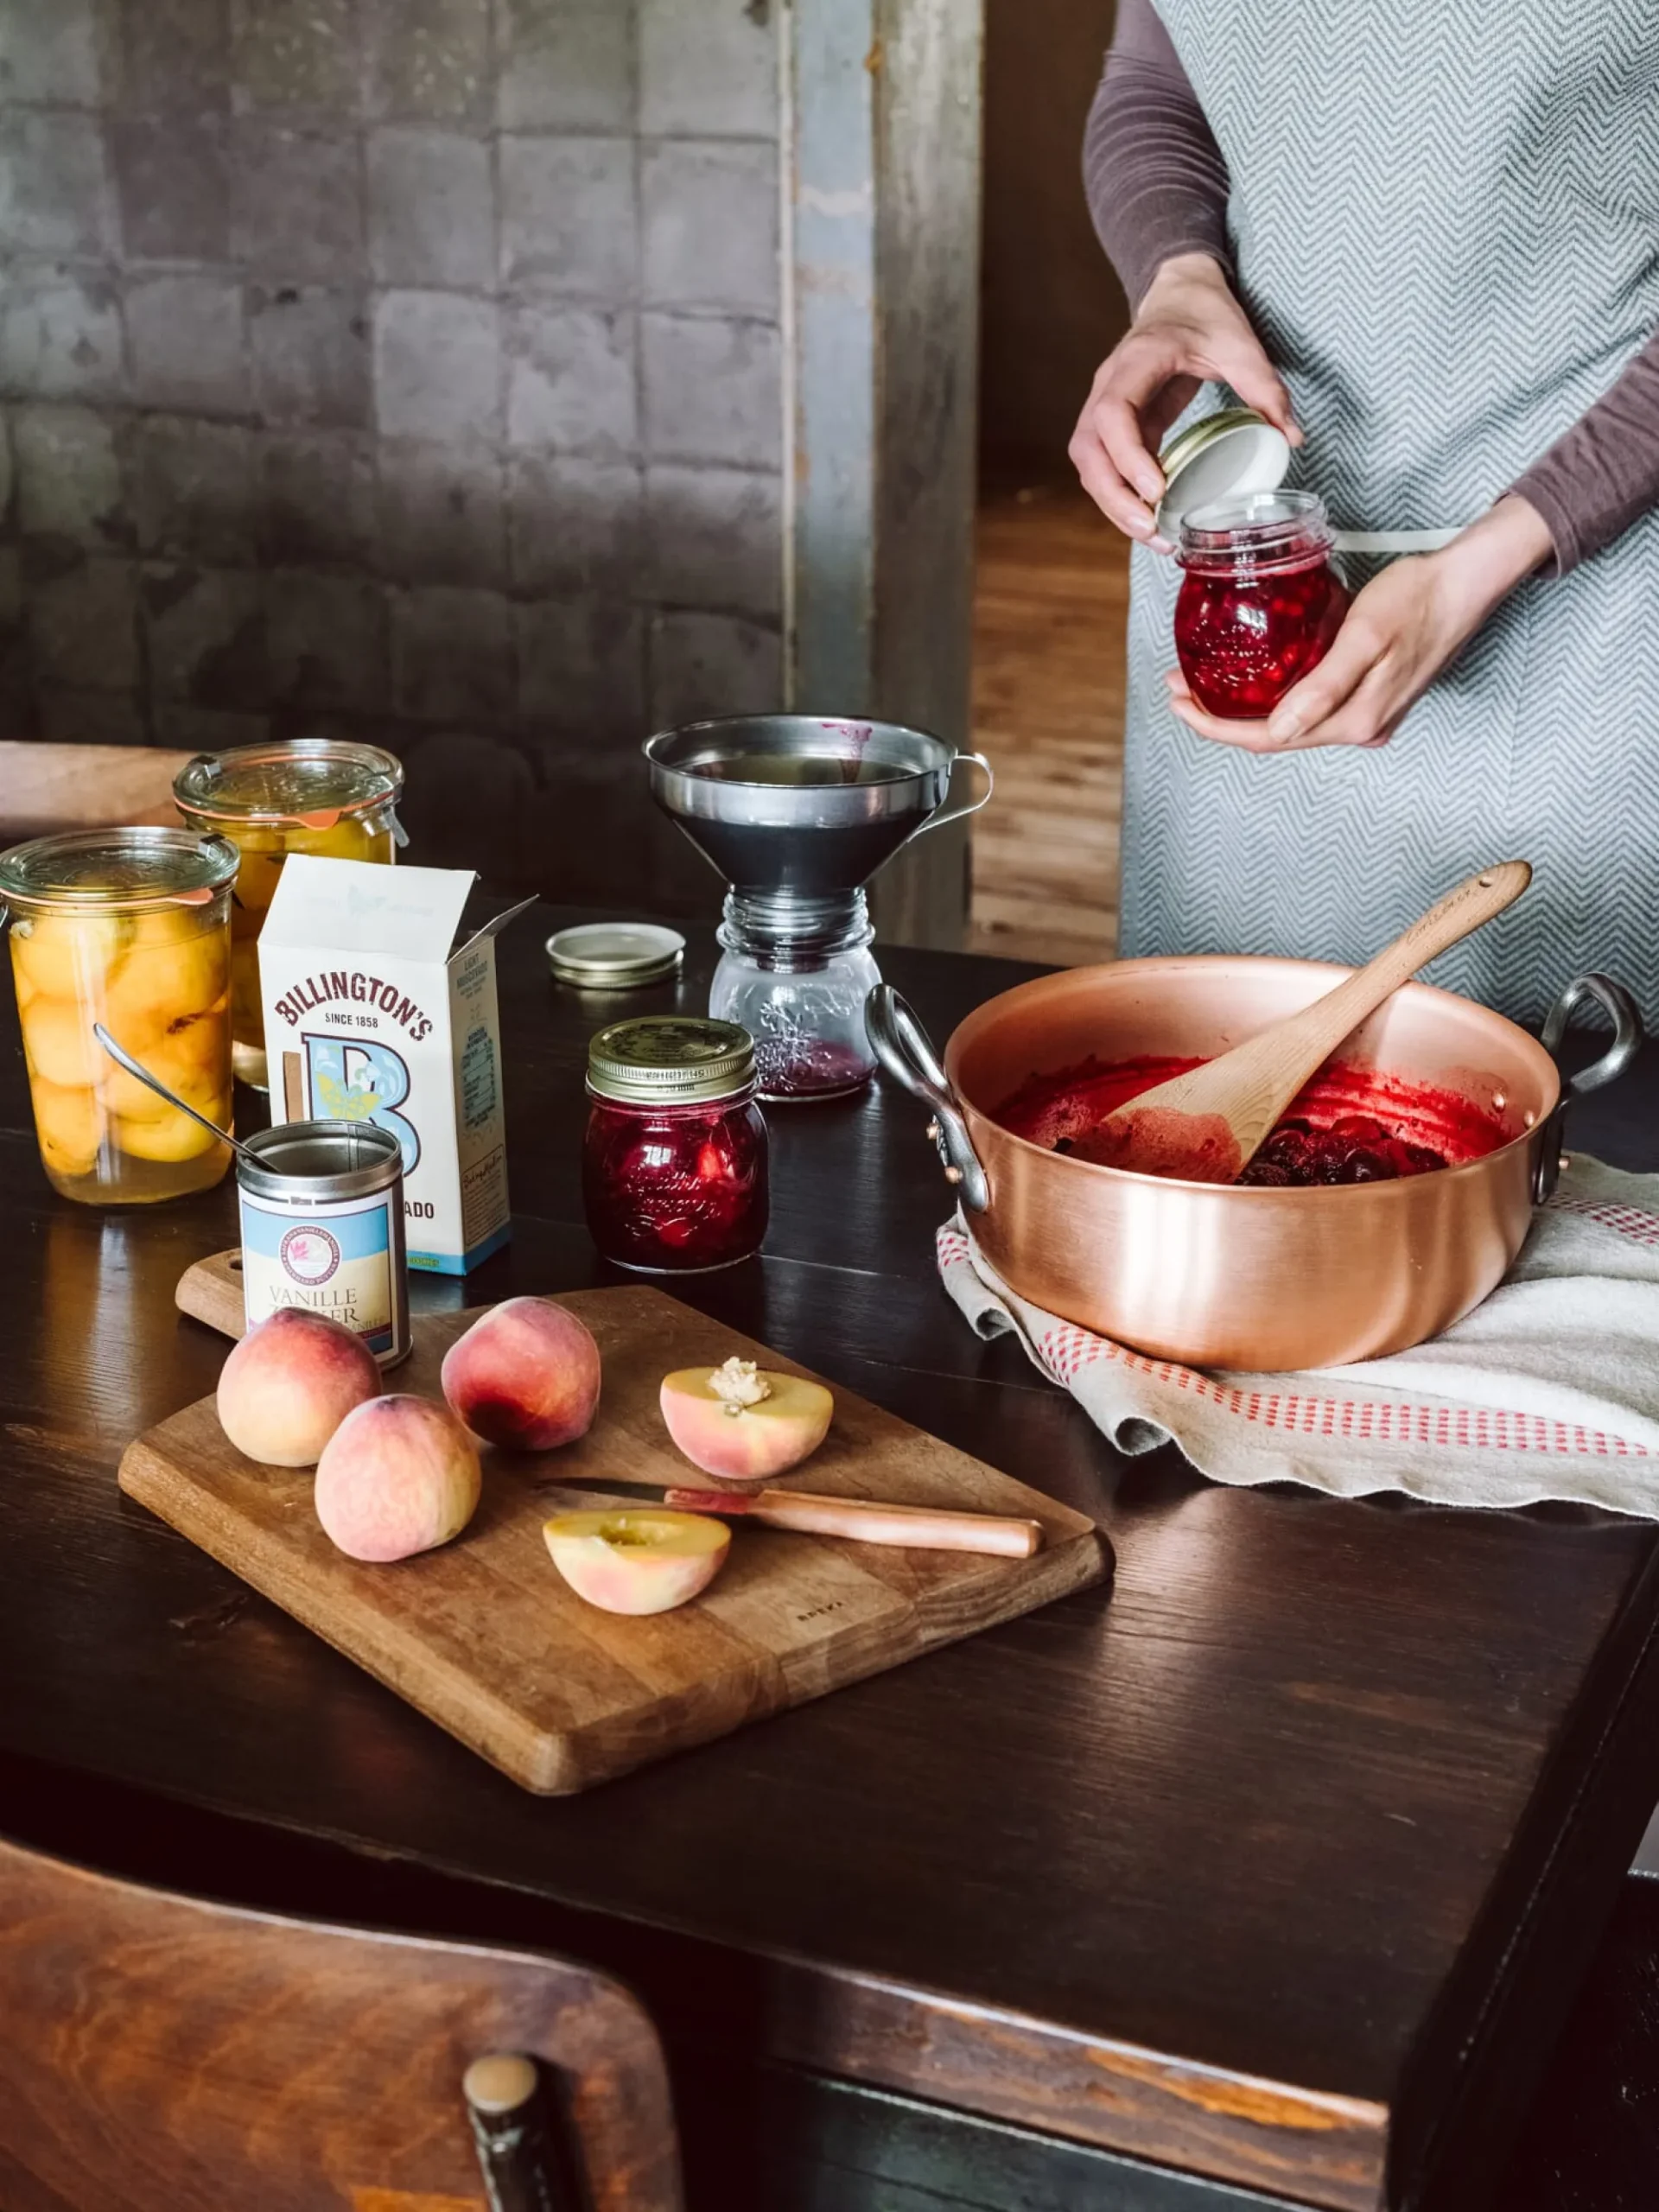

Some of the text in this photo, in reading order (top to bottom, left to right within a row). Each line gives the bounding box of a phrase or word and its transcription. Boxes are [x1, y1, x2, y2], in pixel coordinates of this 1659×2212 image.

[274, 971, 433, 1041] BILLINGTON'S
[325, 1013, 378, 1028] SINCE 1858
[404, 1200, 435, 1219] ADO
[269, 1285, 357, 1306] VANILLE
